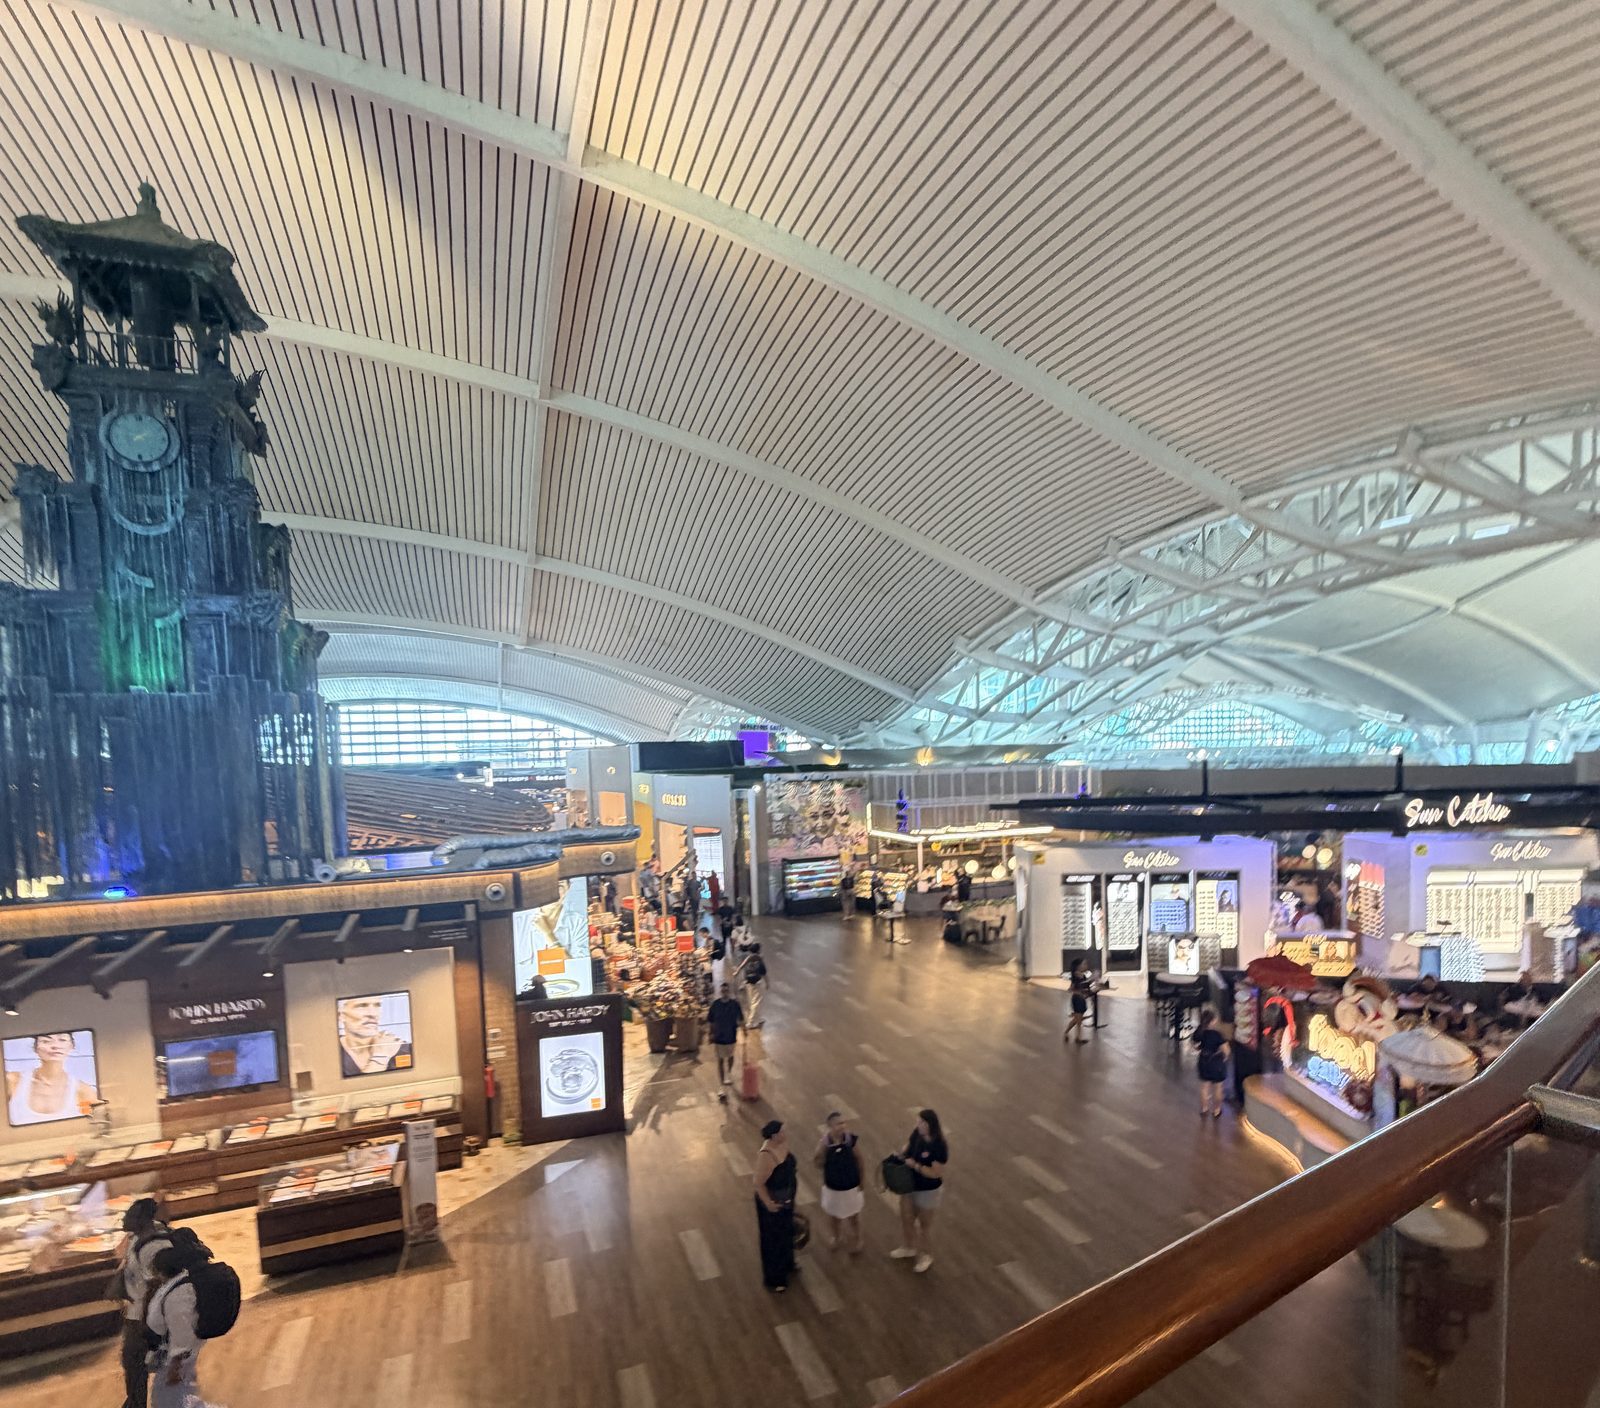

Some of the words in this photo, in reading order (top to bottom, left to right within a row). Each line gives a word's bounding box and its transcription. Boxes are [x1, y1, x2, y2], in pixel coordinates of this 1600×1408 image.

[1404, 797, 1444, 828] Sun
[1446, 791, 1511, 828] Catcher
[566, 1004, 611, 1019] HARDY
